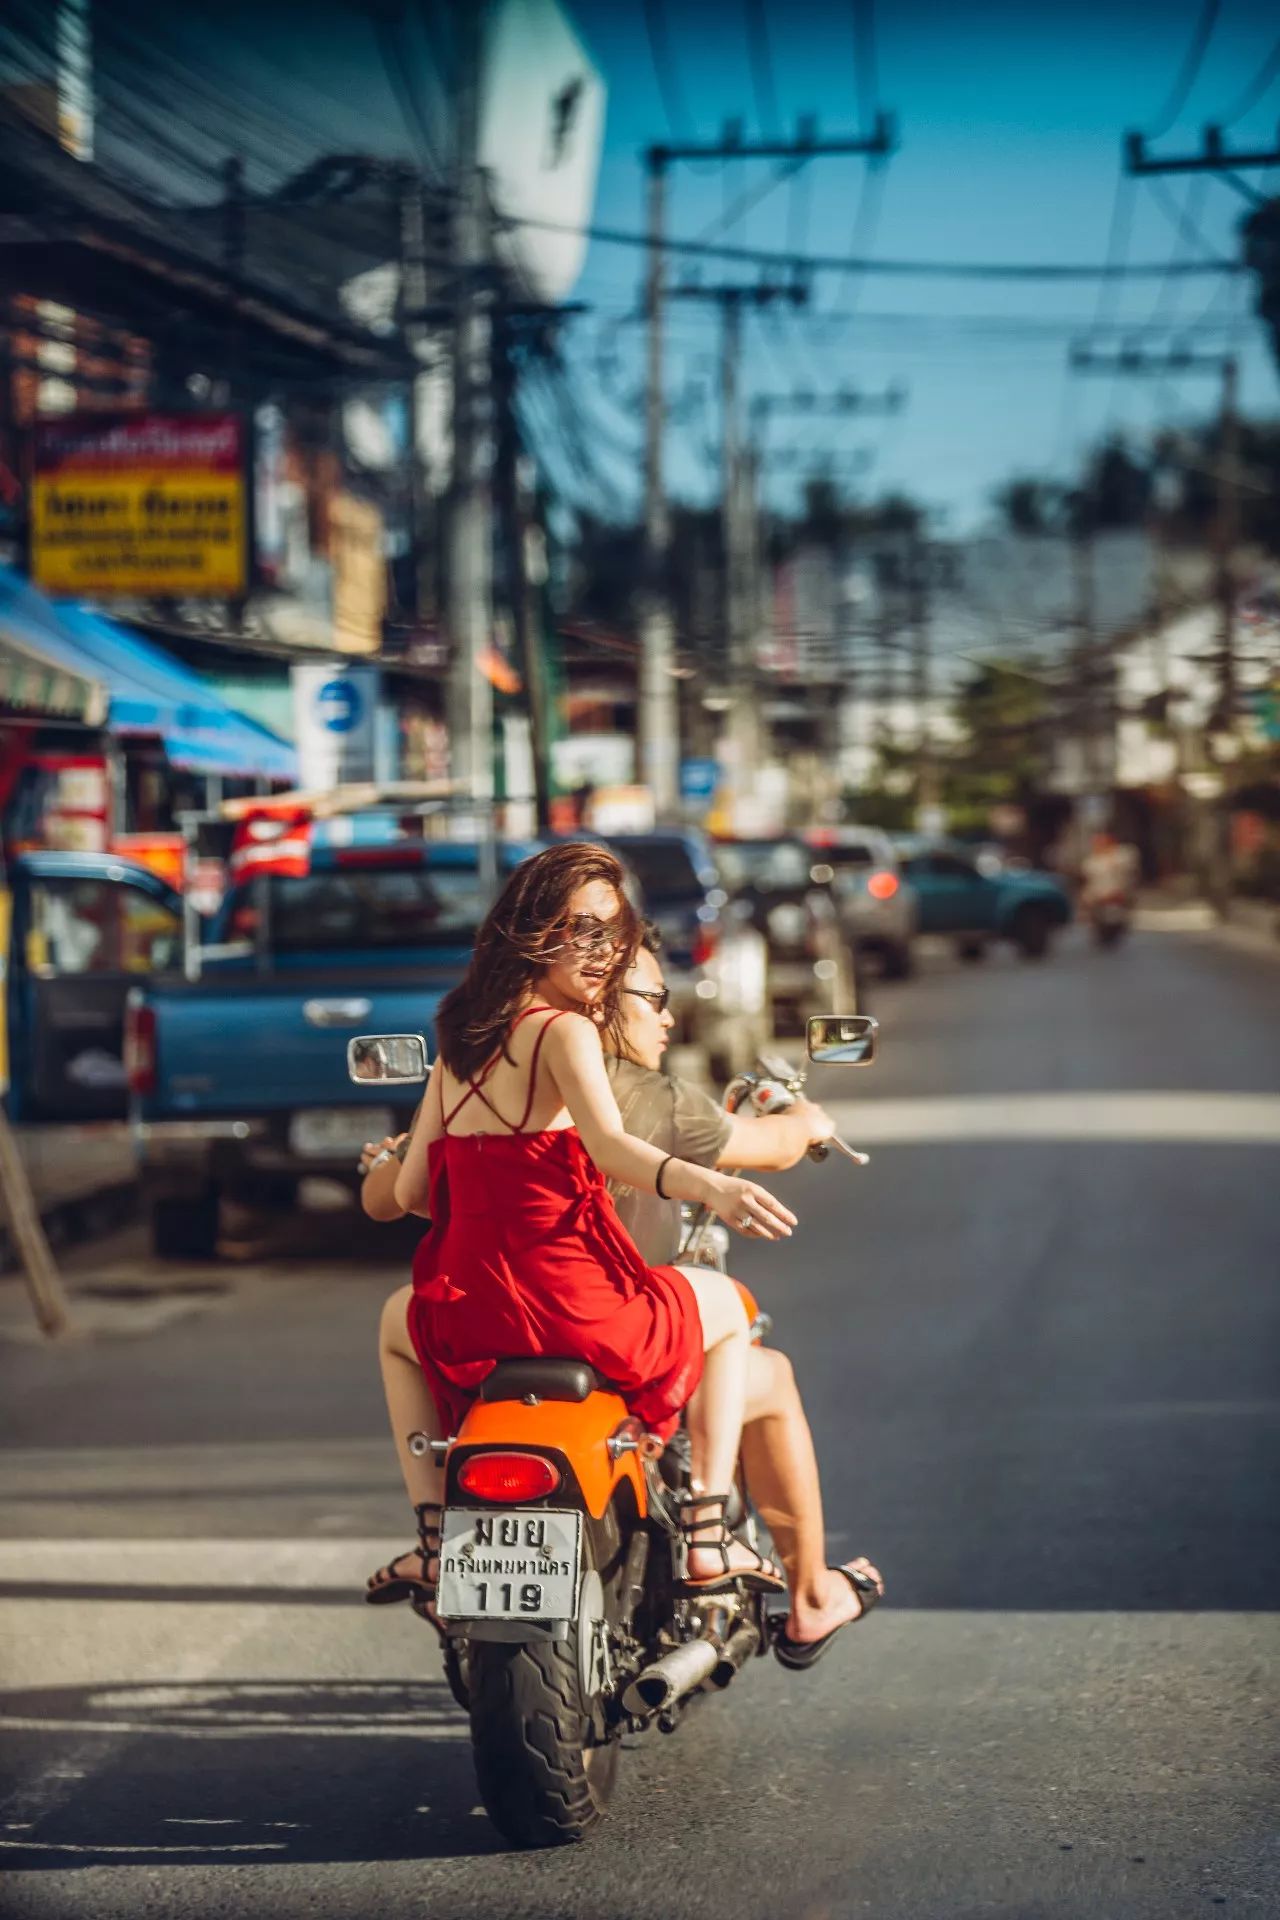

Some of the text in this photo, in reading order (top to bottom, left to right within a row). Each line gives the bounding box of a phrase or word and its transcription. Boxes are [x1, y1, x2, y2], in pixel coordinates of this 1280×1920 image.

[445, 1557, 571, 1579] กรุงเทพมหานคร
[476, 1582, 542, 1612] 119
